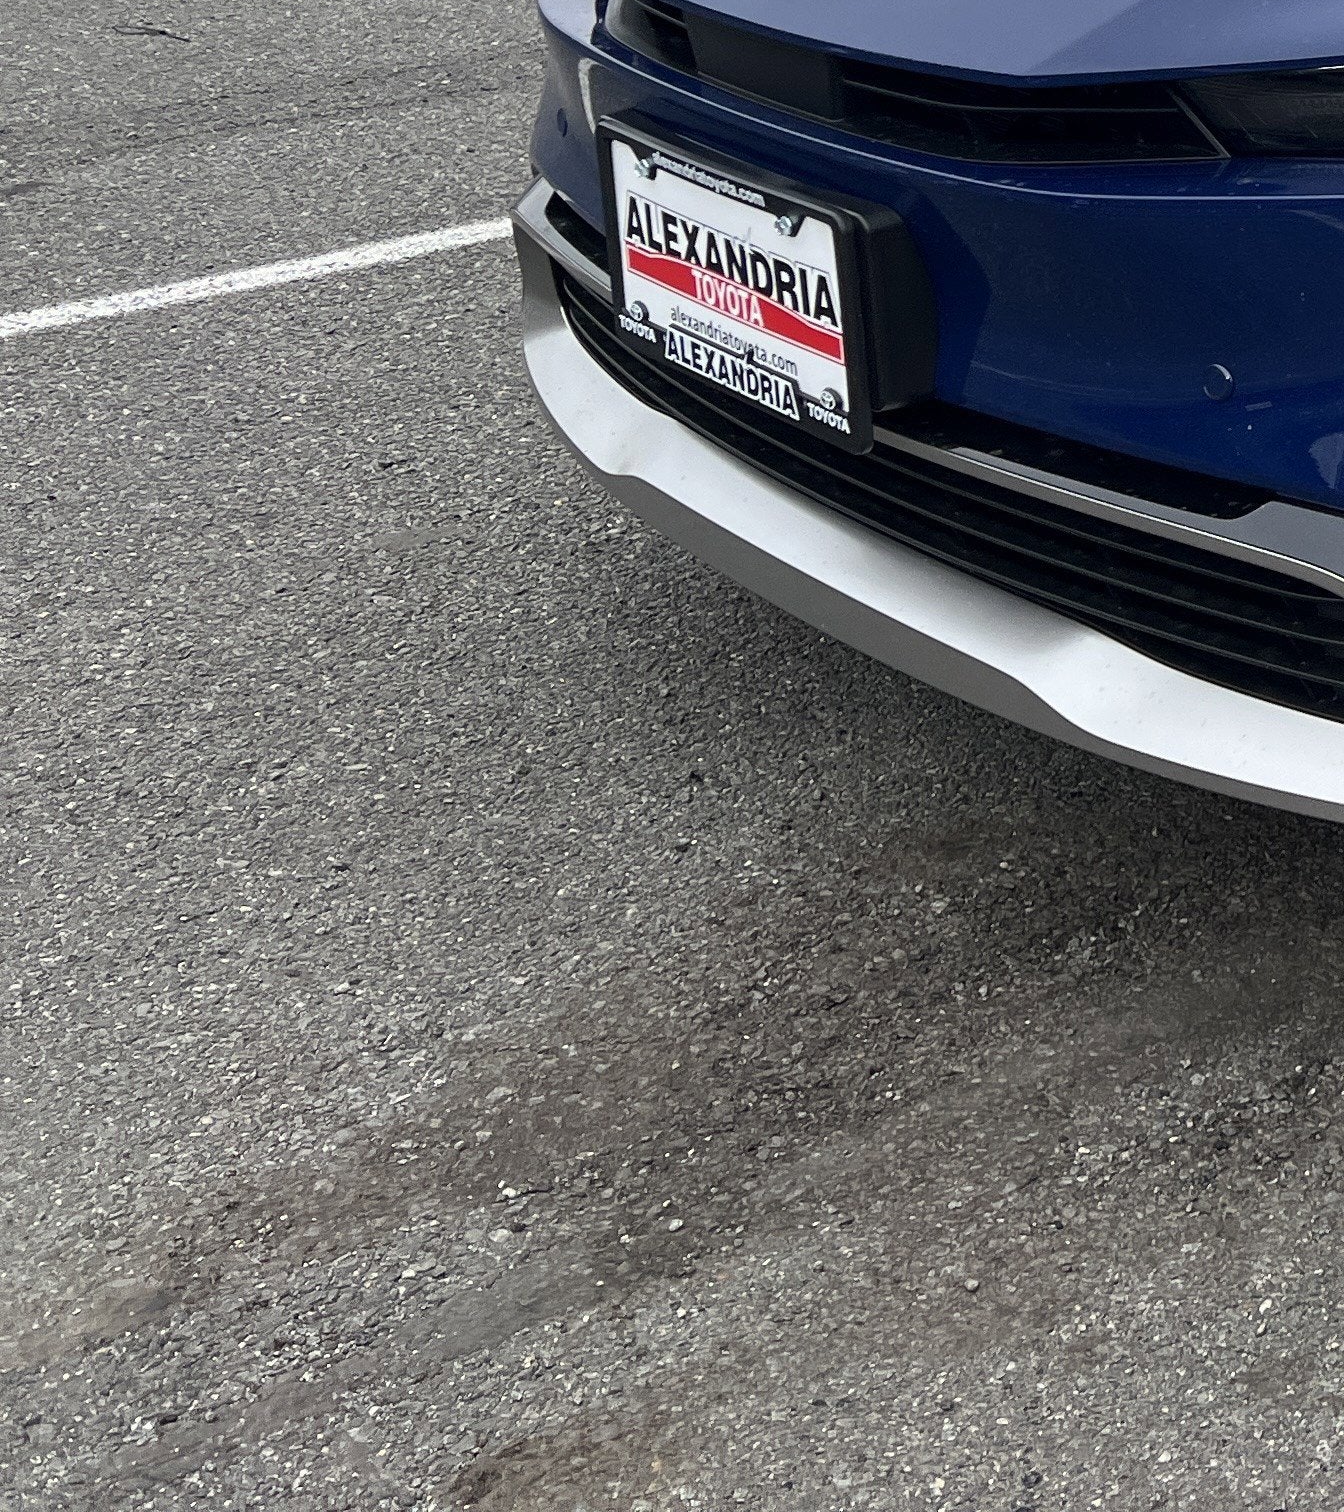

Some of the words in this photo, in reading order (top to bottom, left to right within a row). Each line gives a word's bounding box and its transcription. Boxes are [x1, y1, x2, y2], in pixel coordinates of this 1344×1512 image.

[651, 151, 766, 207] alexandriatoyota.com
[626, 195, 839, 328] ALEXANDRIA
[690, 269, 764, 328] TOYOTA
[618, 314, 657, 343] TOYOTA
[666, 330, 797, 419] ALEXANDRIA
[807, 402, 851, 435] TOYOTA
